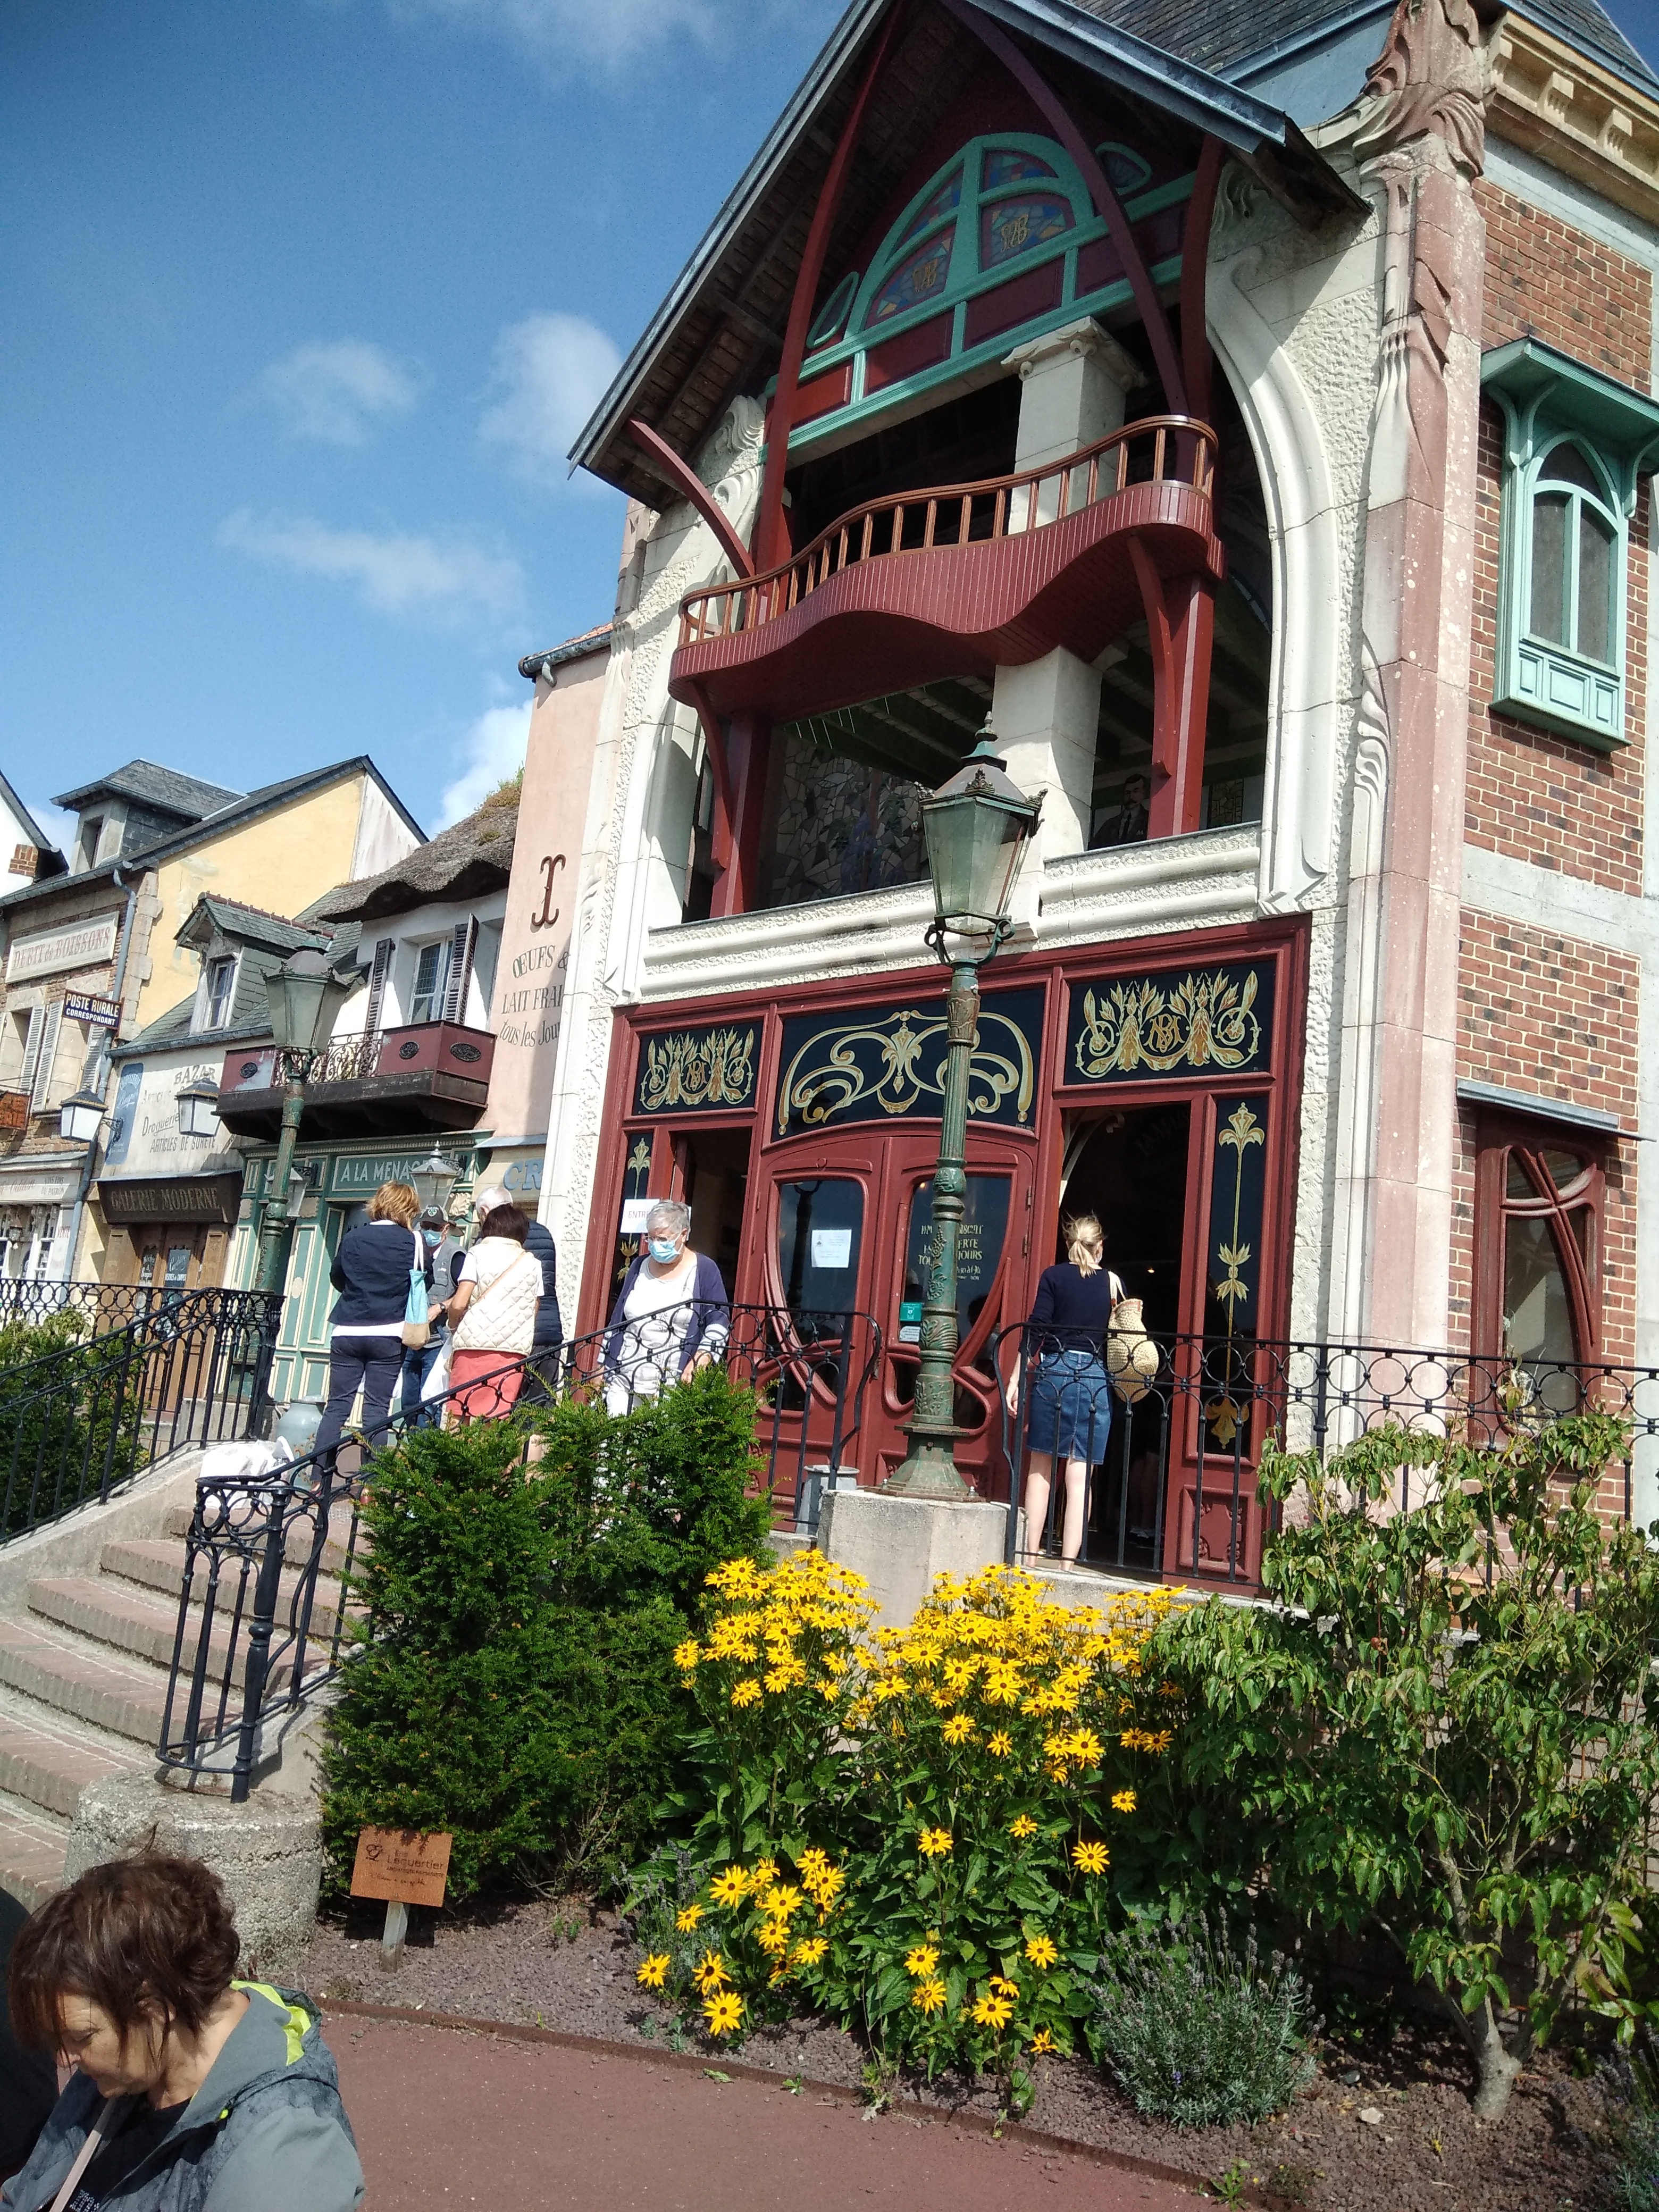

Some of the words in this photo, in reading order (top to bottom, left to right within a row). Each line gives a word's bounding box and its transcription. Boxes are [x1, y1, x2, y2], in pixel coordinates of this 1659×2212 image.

[55, 926, 110, 959] BOISSONS
[65, 993, 90, 1011] POSTE
[91, 1000, 120, 1018] RURALE
[501, 990, 530, 1014] LAIT
[532, 985, 563, 1010] FRAI
[66, 1008, 115, 1026] CORRESPONDANT
[500, 1019, 521, 1045] tous
[520, 1021, 536, 1047] les
[150, 1136, 178, 1153] ARTICLES
[180, 1136, 190, 1151] DE
[340, 1161, 350, 1182] A
[354, 1161, 368, 1182] LA
[111, 1189, 158, 1212] GALERIE
[161, 1187, 220, 1211] MODERNE
